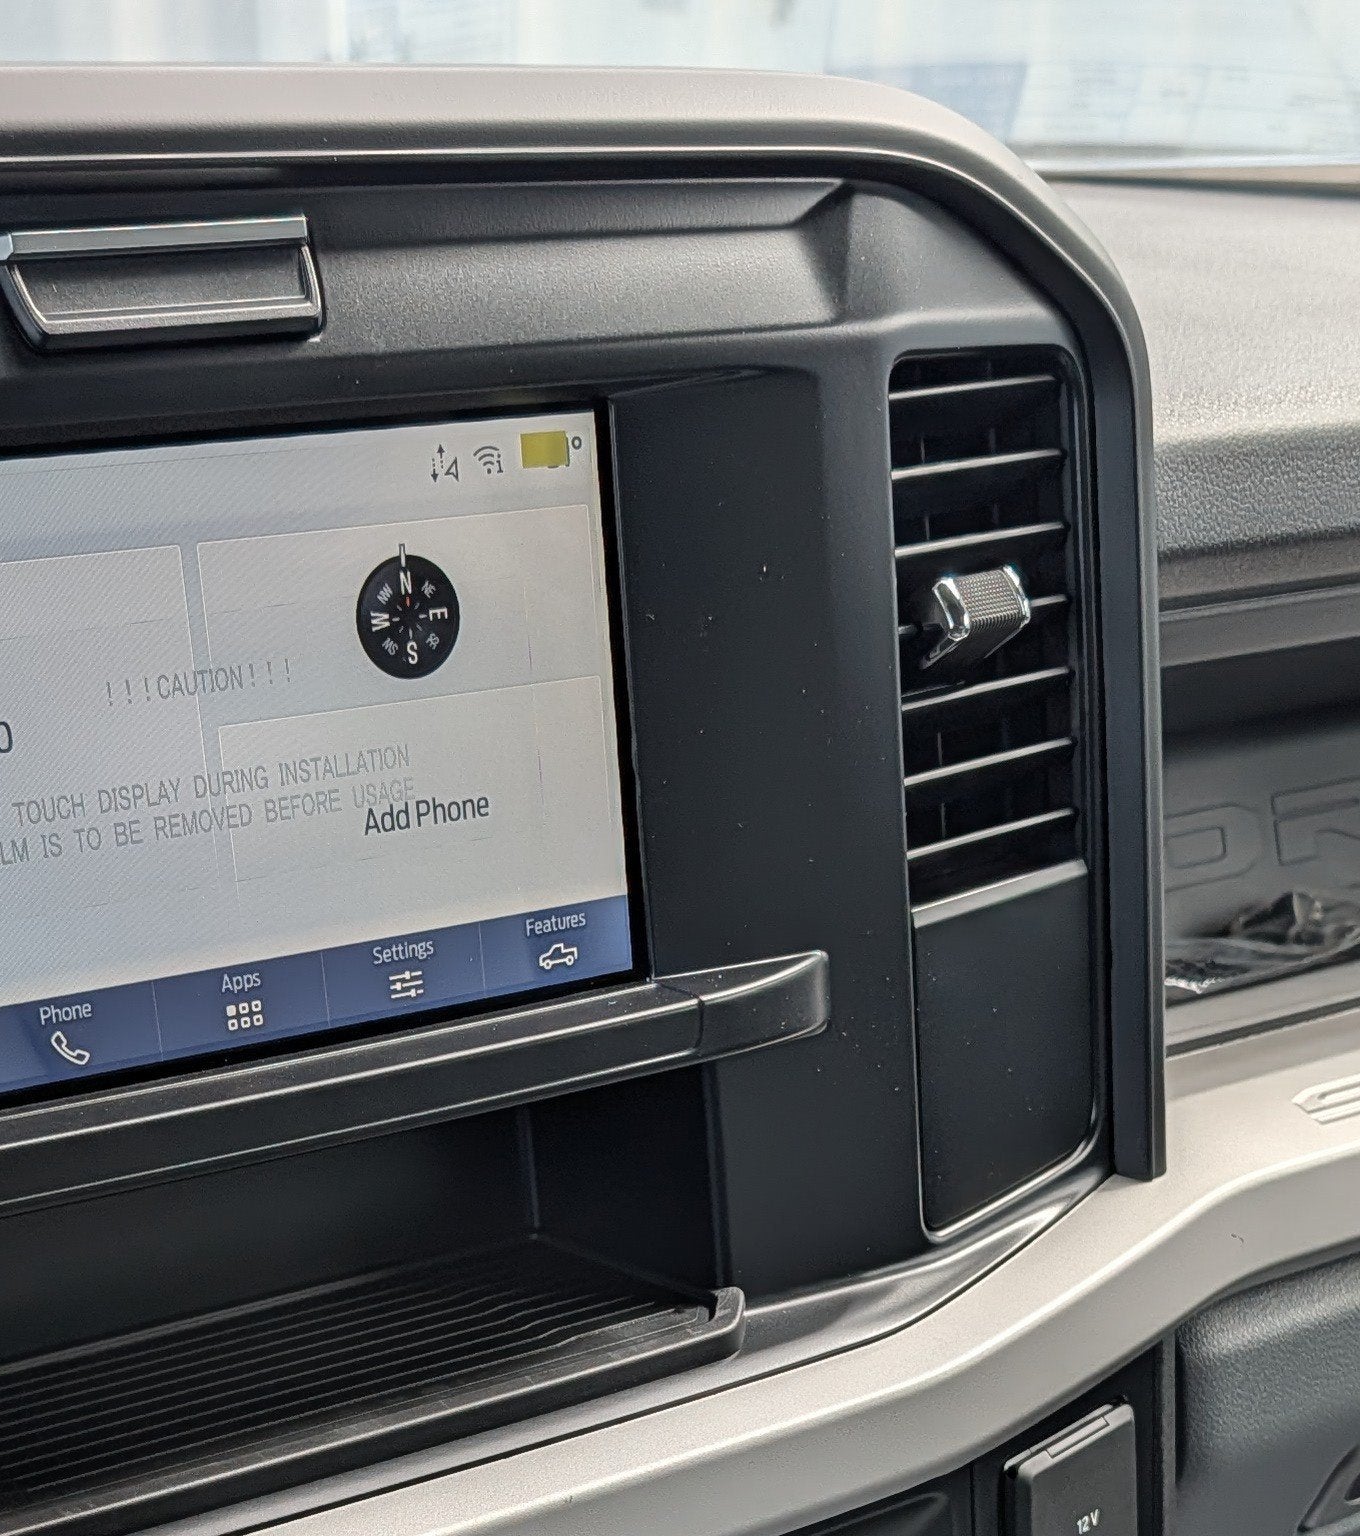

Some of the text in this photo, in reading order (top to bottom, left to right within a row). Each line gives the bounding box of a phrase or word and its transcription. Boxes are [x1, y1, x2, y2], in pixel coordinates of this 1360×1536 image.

[11, 793, 87, 827] TOUCH
[97, 777, 182, 815] DISPLAY
[193, 765, 269, 800] DURING
[278, 743, 410, 787] INSTALLATION
[40, 832, 64, 859] IS
[72, 827, 102, 853] TO
[113, 819, 144, 848] BE
[153, 803, 253, 841] REMOVED
[264, 788, 343, 824] BEFORE
[351, 776, 417, 809] USAGE
[364, 796, 490, 836] Add Phone
[525, 911, 588, 937] Features
[372, 939, 435, 966] Settings
[221, 970, 262, 994] Apps
[39, 1001, 93, 1026] Phone
